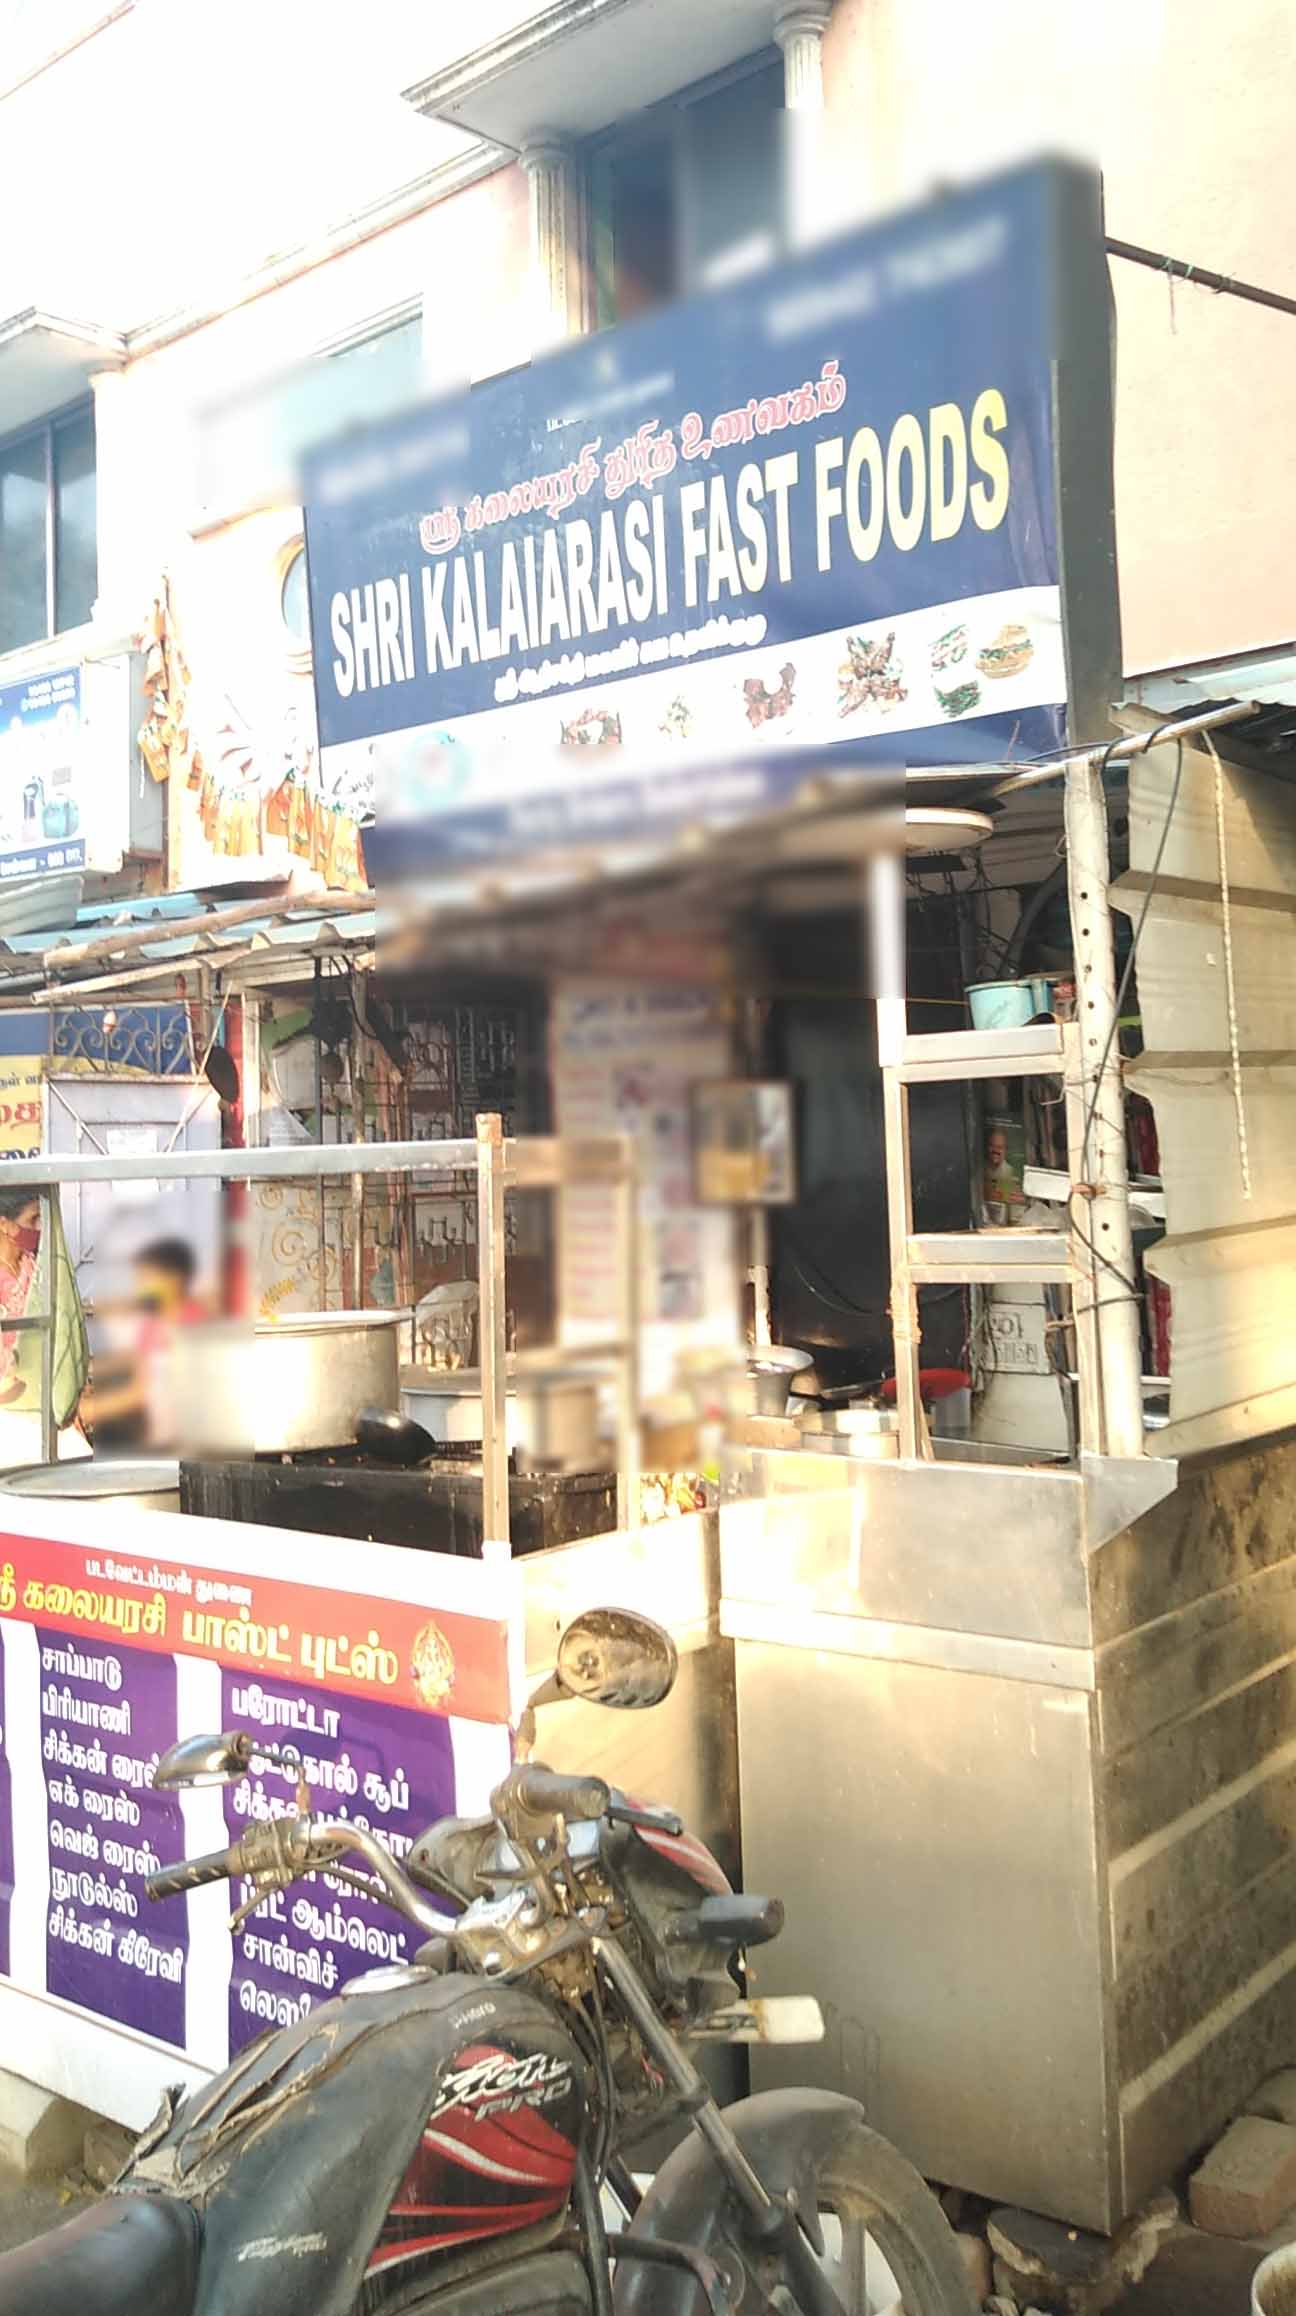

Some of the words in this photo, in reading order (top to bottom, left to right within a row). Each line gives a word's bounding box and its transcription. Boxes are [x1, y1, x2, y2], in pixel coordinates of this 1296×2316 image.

[464, 437, 603, 520] கலையரசி
[680, 360, 847, 460] உணவகம்
[331, 572, 415, 698] SHRI
[421, 494, 669, 675] KALAIARASI
[680, 451, 799, 608] FAST
[815, 389, 1010, 573] FOODS
[23, 1581, 166, 1637] கலையரசி
[182, 1605, 293, 1664] பாஸ்ட்
[300, 1630, 399, 1685] புட்ஸ்
[41, 1643, 123, 1691] சாப்பாடு
[42, 1683, 132, 1737] பிரியாணி
[231, 1684, 341, 1739] பரோட்டா
[43, 1728, 108, 1776] சிக்கன்
[49, 1774, 80, 1809] எக்
[83, 1789, 140, 1827] ரைஸ்
[363, 1767, 409, 1813] சூப்
[50, 1819, 100, 1861] வெஜ்
[51, 1867, 139, 1918] நூடுல்ஸ்
[50, 1904, 115, 1958] சிக்கன்
[117, 1928, 184, 1985] கிரேவி
[291, 1898, 409, 1966] ஆம்லெட்
[243, 1933, 339, 1990] சான்விச்
